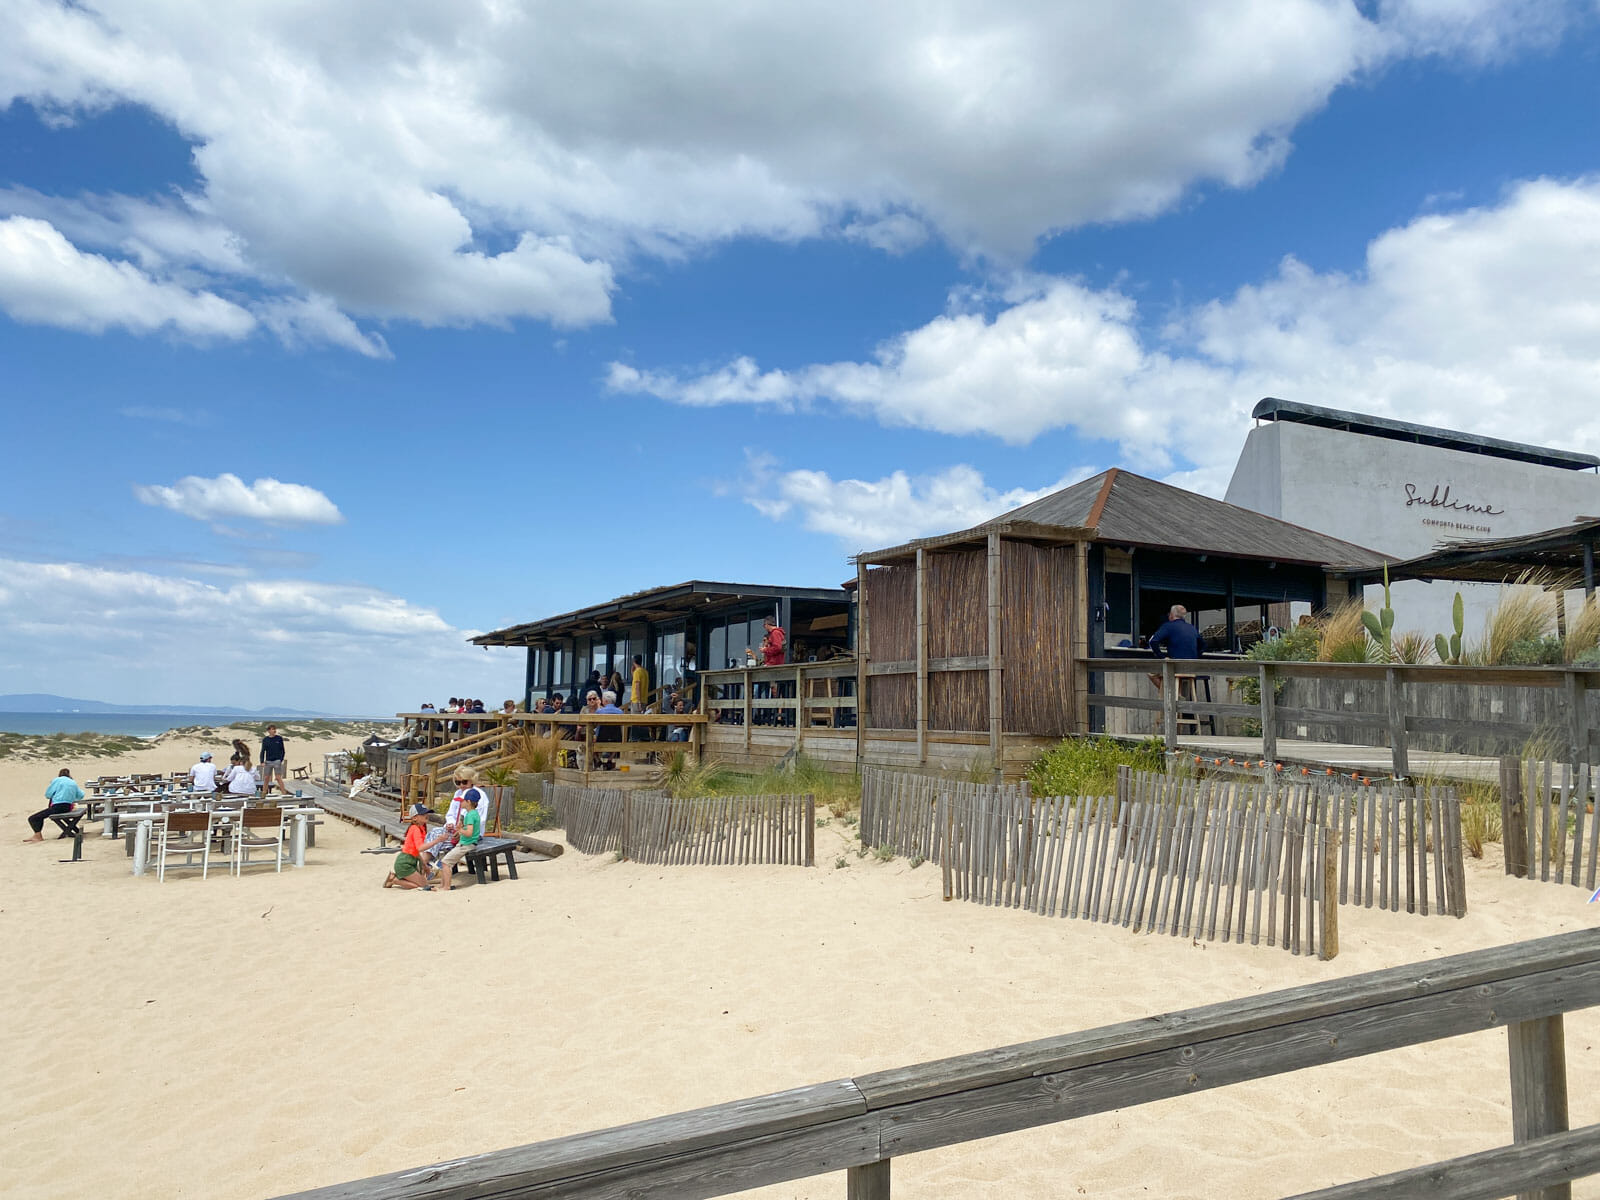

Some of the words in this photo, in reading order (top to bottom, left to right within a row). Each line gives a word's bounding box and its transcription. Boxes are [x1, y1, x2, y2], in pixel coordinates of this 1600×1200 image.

[1405, 483, 1504, 515] Sublime
[1422, 518, 1454, 528] COMPORTA
[1456, 522, 1474, 531] BEACH
[1476, 525, 1491, 533] CLUB
